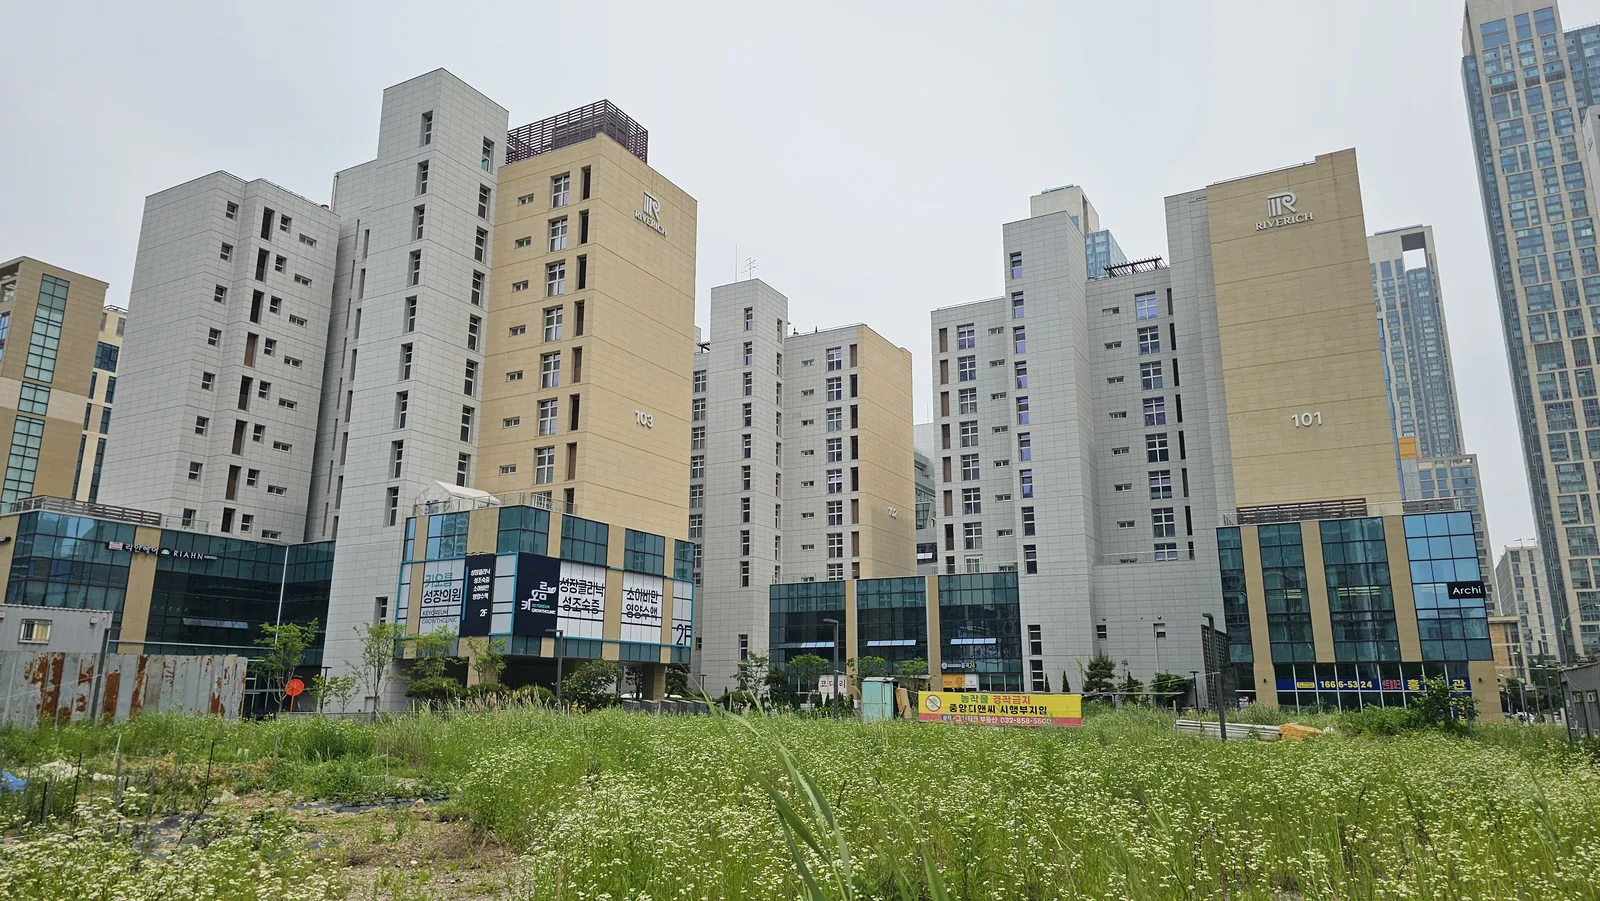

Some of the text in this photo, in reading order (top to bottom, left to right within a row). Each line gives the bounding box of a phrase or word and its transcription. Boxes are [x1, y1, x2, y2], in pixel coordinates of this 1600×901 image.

[634, 210, 667, 235] RIVERICH
[1255, 212, 1314, 231] RIVERICH
[635, 410, 654, 428] 103
[1291, 411, 1322, 428] 101
[173, 549, 204, 560] RIAHN
[560, 577, 605, 597] 성장클리닉
[626, 587, 658, 604] 소아비만
[1452, 586, 1482, 595] Archi
[424, 588, 461, 604] 성장의원
[480, 609, 487, 617] 2F
[562, 596, 600, 614] 성조숙증
[676, 624, 692, 646] 2F
[1320, 680, 1373, 689] 1666-5324
[961, 695, 1031, 705] 농작물 경작금지
[949, 704, 996, 714] 중앙디앤씨
